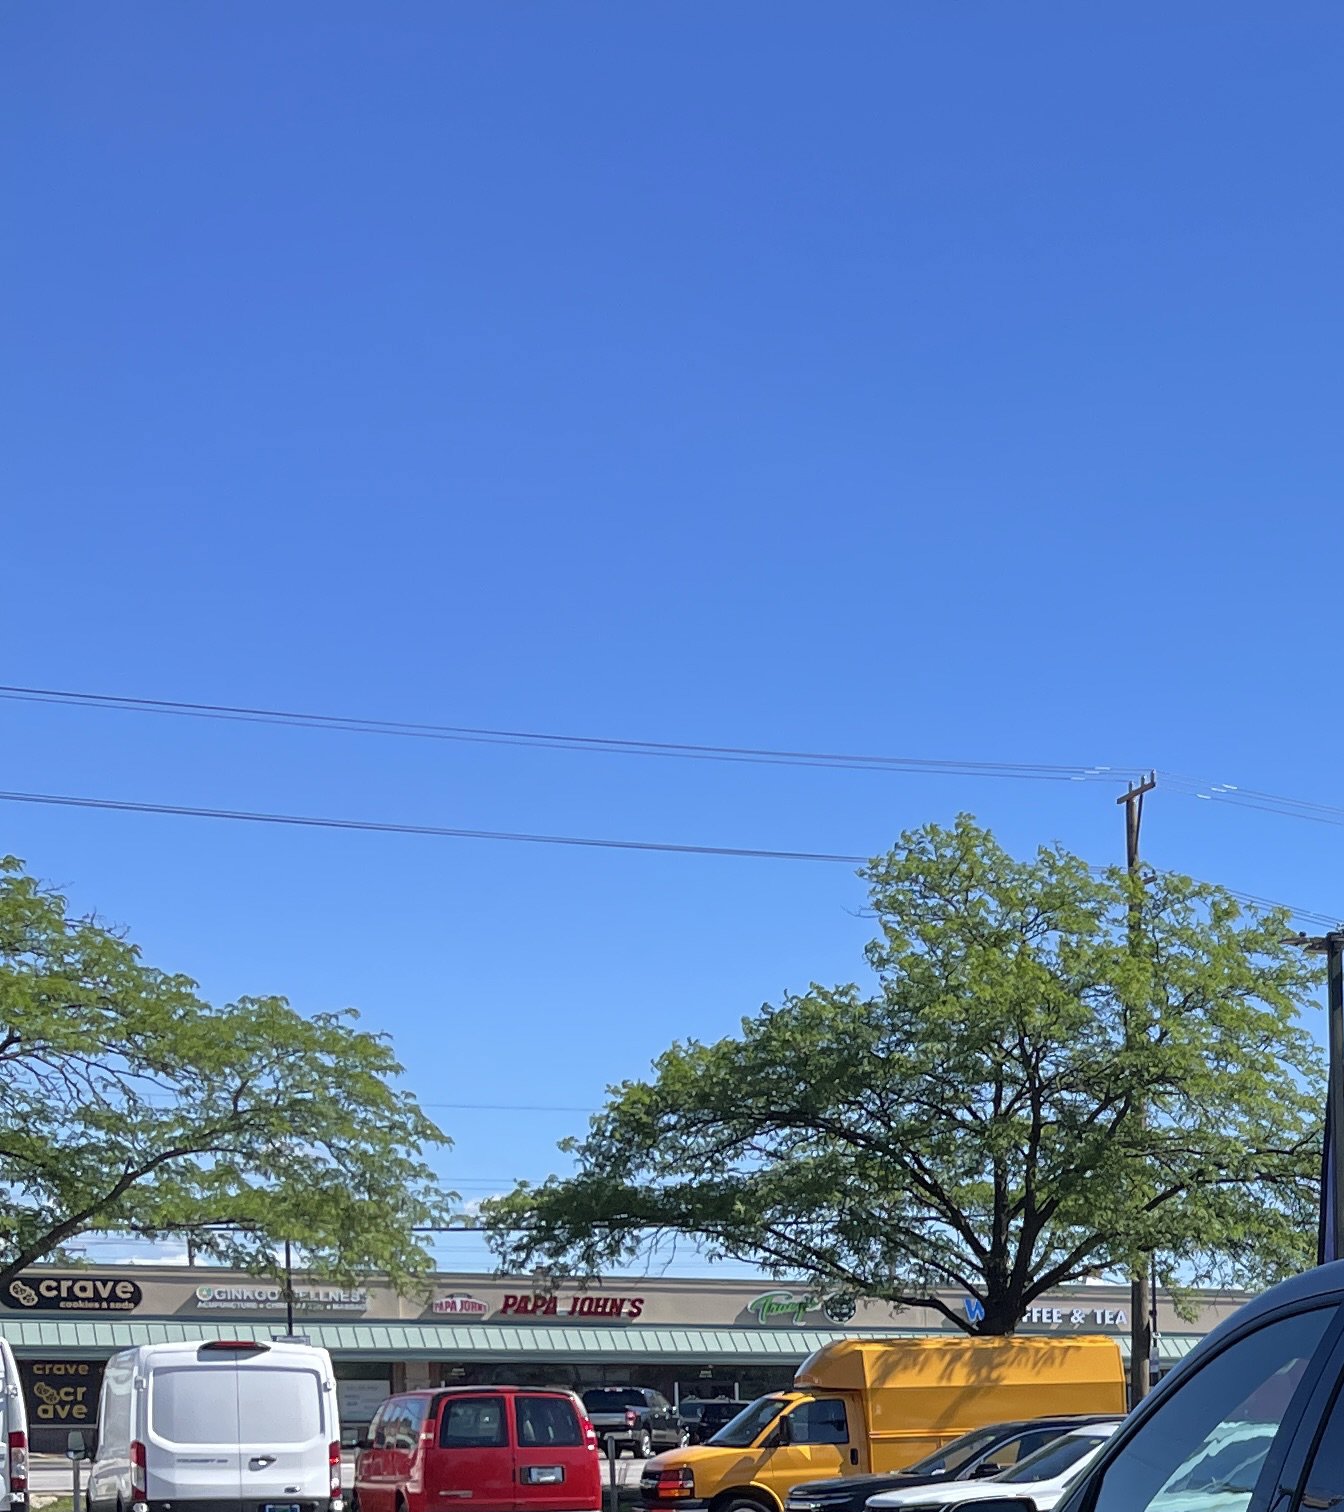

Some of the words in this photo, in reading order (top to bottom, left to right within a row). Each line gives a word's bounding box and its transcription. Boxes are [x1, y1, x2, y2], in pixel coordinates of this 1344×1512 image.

[39, 1279, 135, 1299] crave
[214, 1287, 279, 1301] GINKGO
[500, 1294, 559, 1316] PAPA
[567, 1296, 645, 1319] JOHN'S
[1070, 1308, 1086, 1324] &
[1093, 1308, 1128, 1325] TEA
[32, 1363, 89, 1375] crave
[60, 1386, 87, 1401] cr
[37, 1404, 88, 1419] ave
